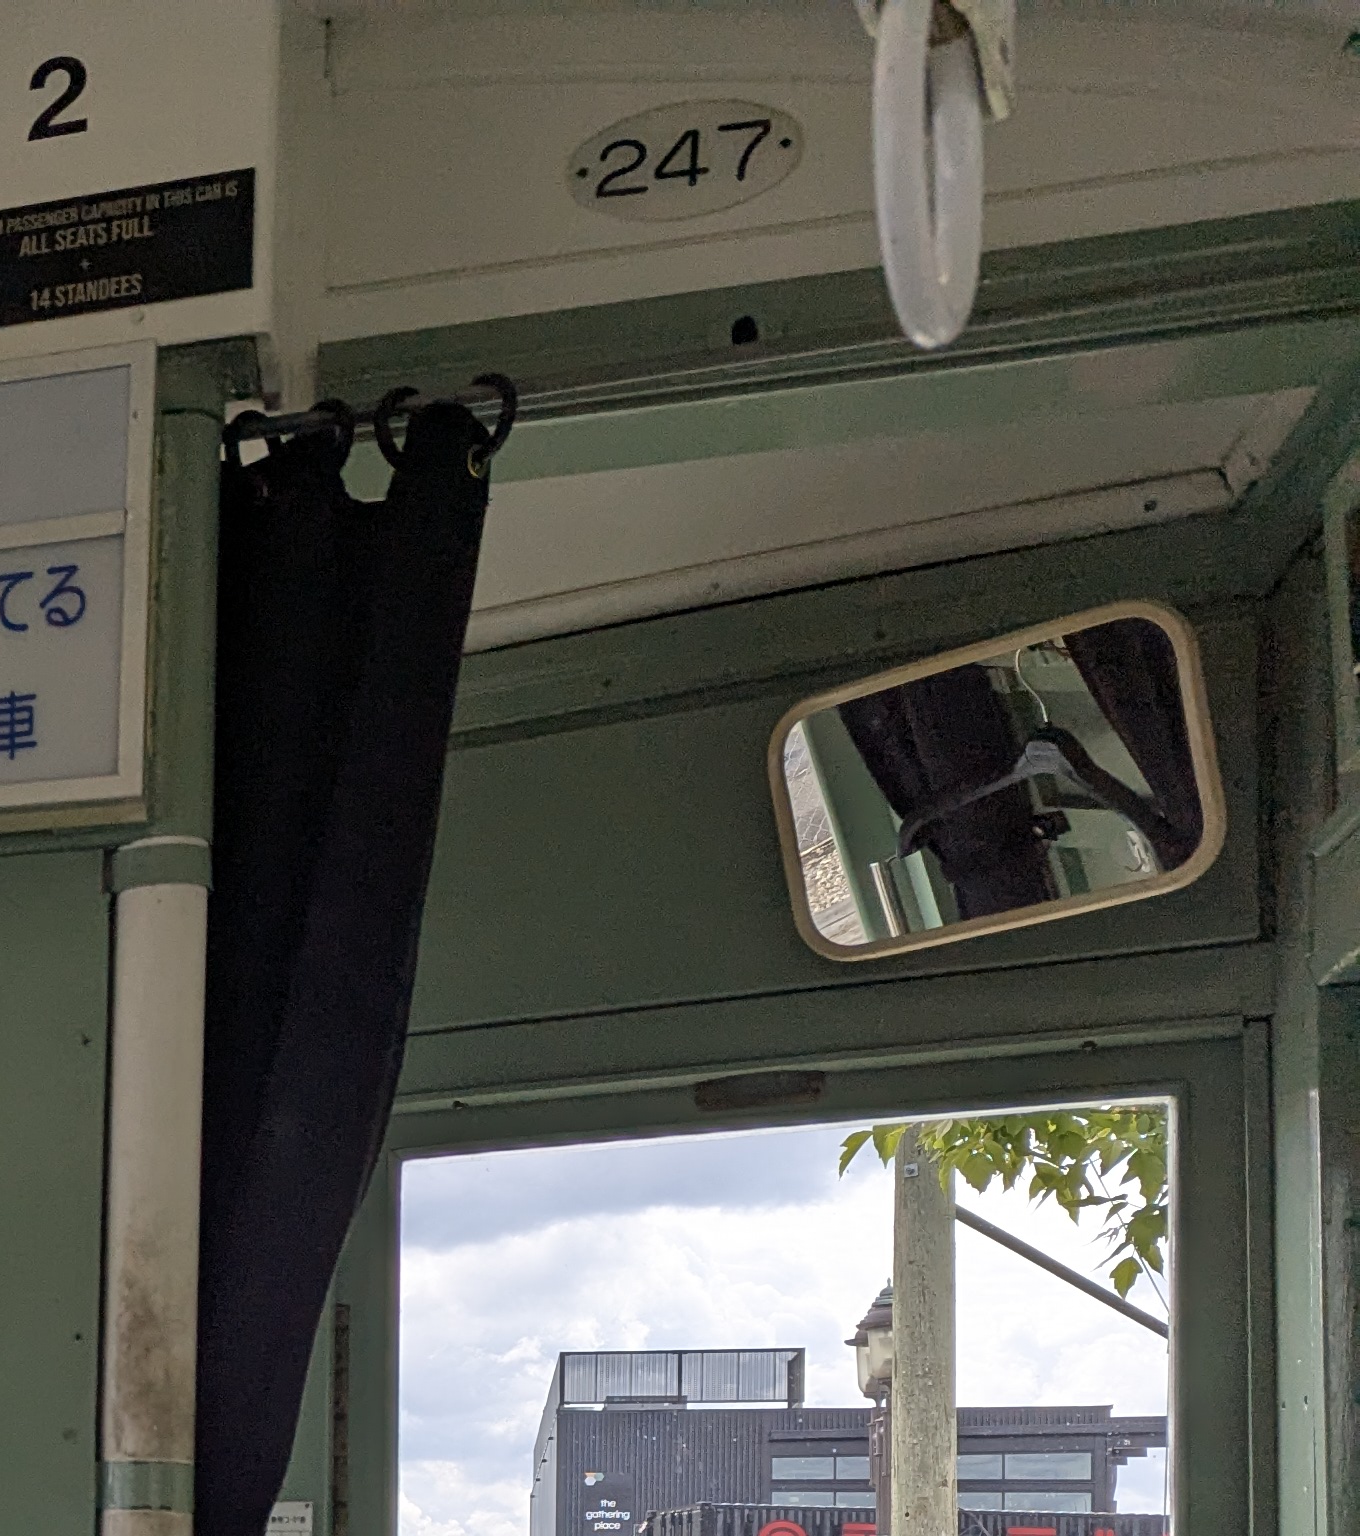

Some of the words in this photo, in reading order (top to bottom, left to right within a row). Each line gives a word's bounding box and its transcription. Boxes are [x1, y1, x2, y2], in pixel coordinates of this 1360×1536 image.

[27, 56, 88, 142] 2
[596, 119, 771, 198] 247
[7, 206, 79, 234] PASSENGER
[81, 197, 142, 220] CAPACITY
[225, 180, 238, 198] IS
[19, 235, 51, 258] ALL
[55, 223, 108, 251] SEATS
[111, 215, 155, 243] FULL
[29, 289, 51, 312] 14
[55, 273, 142, 308] STANDEES
[586, 1510, 630, 1521] gathering
[601, 1499, 616, 1508] the
[594, 1521, 621, 1531] place
